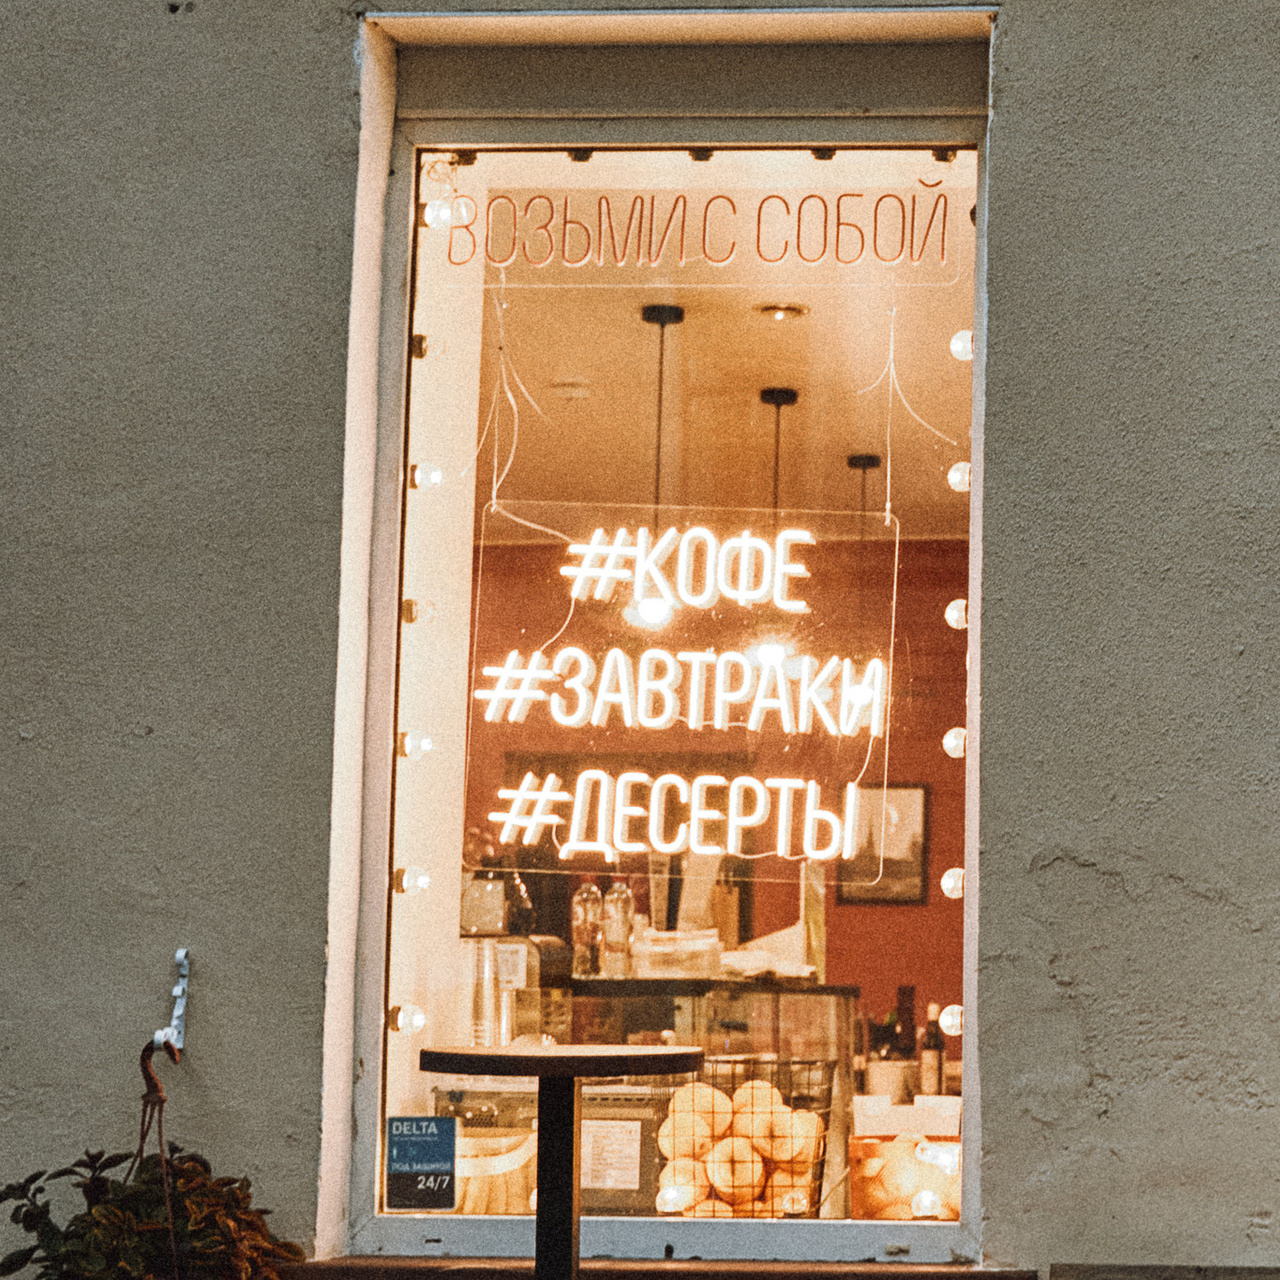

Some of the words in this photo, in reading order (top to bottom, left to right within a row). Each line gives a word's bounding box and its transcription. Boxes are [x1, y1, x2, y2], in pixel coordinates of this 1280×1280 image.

[448, 195, 687, 266] ВОЗЬМИ
[702, 195, 738, 265] С
[756, 179, 948, 265] СОБОЙ
[559, 527, 815, 613] #КОФЕ
[473, 646, 883, 738] #ЗАВТРАКИ
[487, 769, 856, 863] #ДЕСЕРТЫ
[392, 1121, 438, 1135] DELTA
[417, 1175, 450, 1191] 24/7
